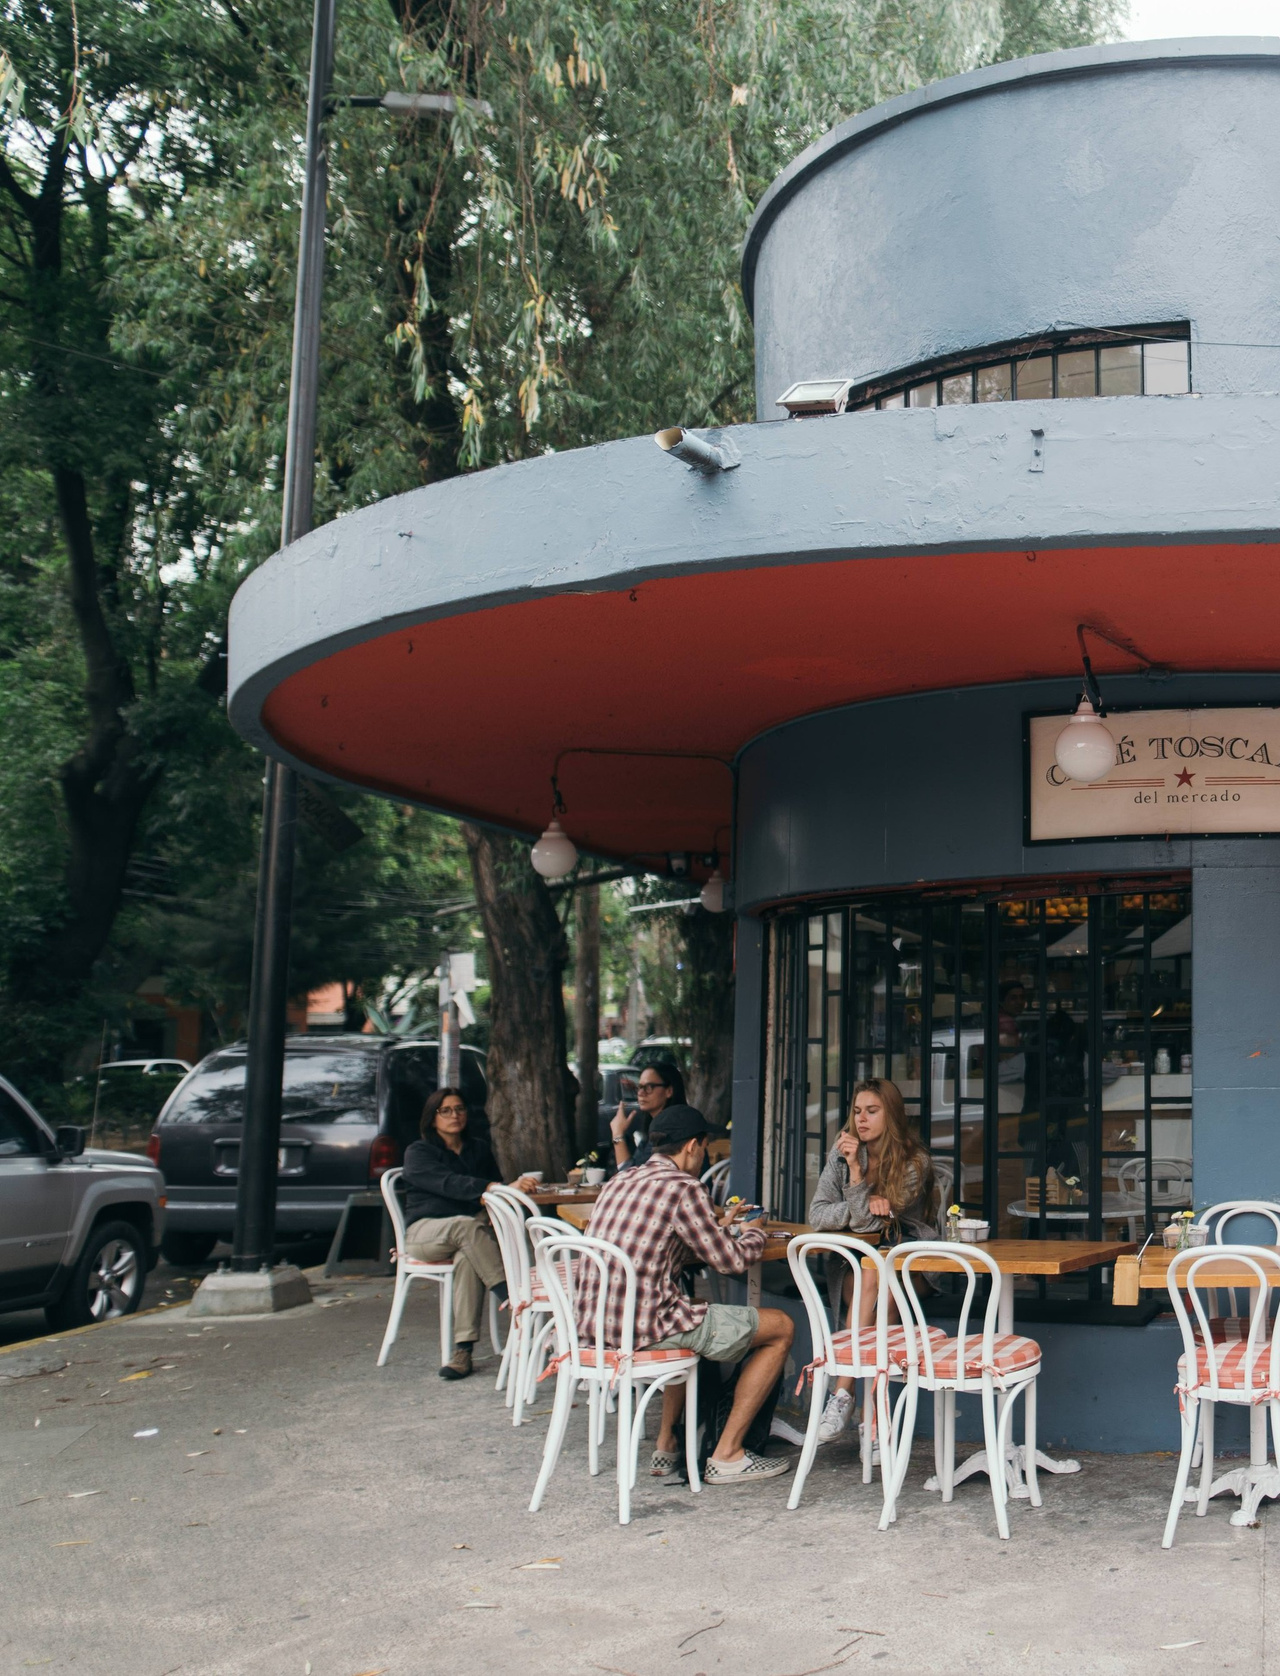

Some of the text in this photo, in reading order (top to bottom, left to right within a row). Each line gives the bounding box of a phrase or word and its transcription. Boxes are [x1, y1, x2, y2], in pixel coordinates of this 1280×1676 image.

[1046, 735, 1136, 787] CÉ
[1134, 789, 1241, 804] del mercado
